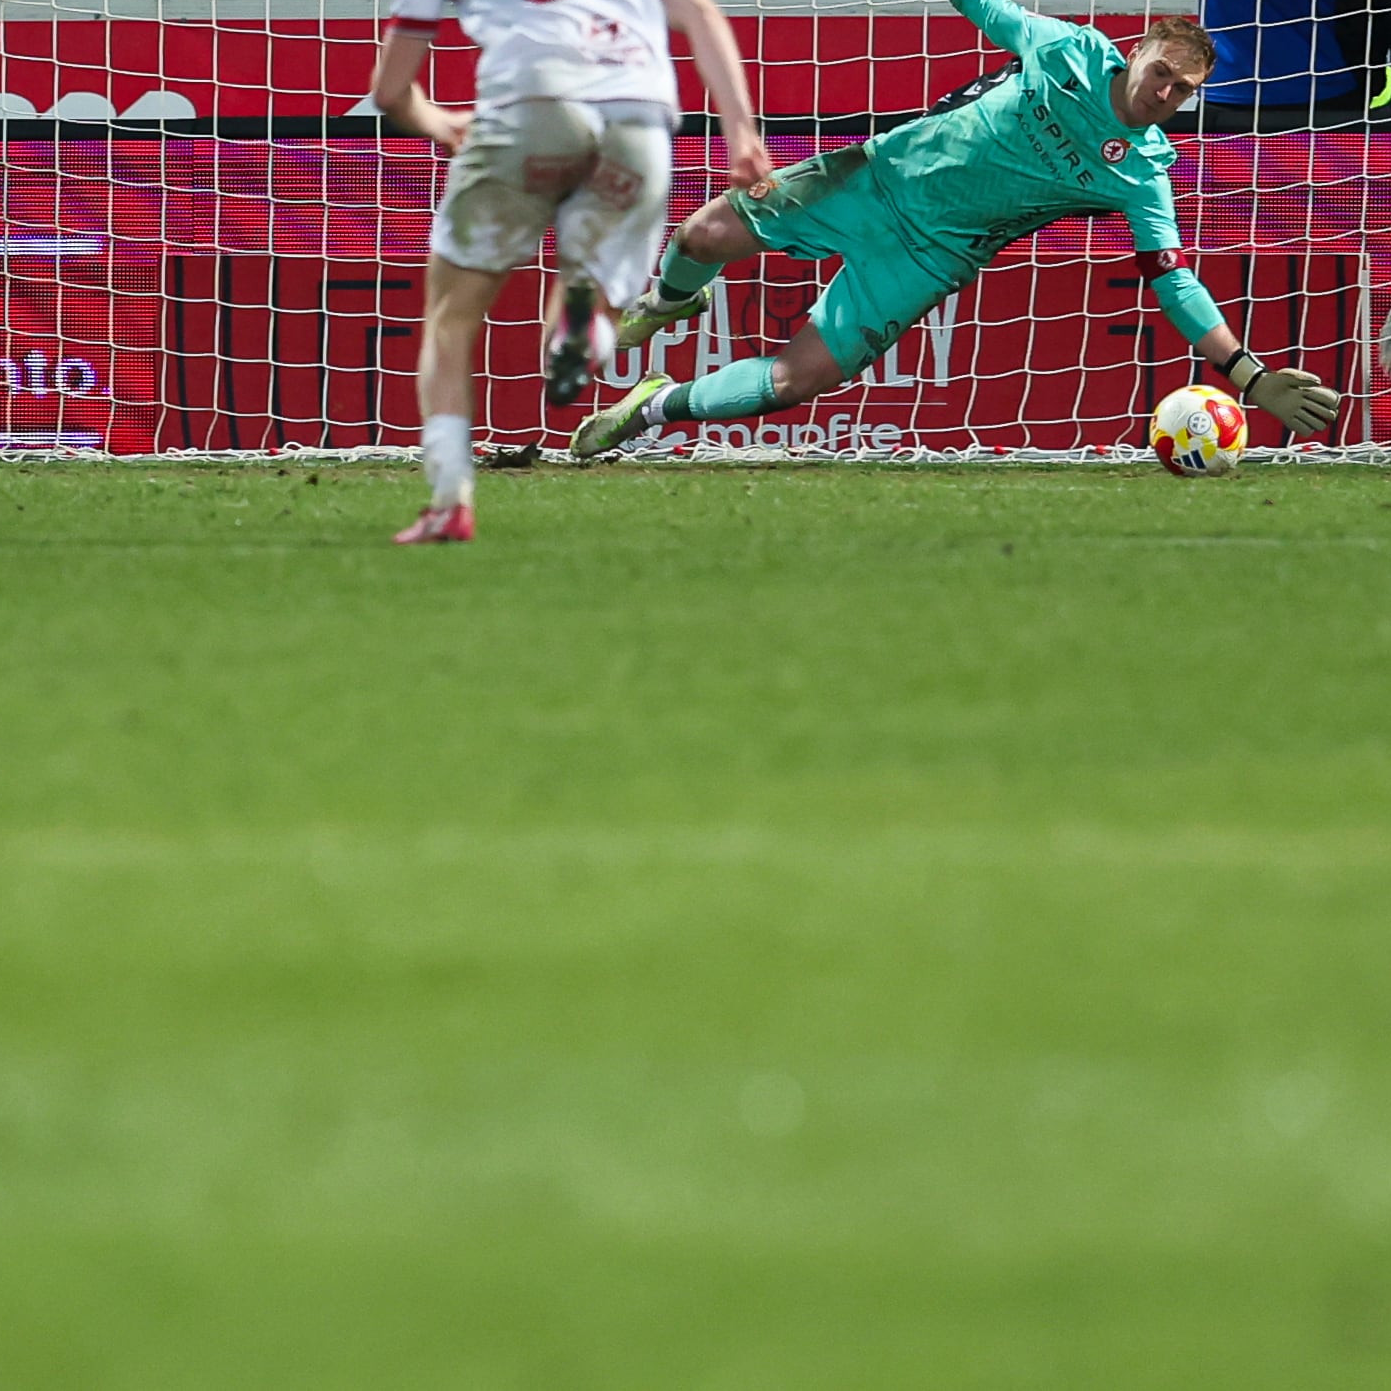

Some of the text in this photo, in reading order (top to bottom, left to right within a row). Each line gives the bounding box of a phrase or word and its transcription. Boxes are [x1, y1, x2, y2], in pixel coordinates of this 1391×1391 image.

[1014, 112, 1066, 182] ACADEMY
[1022, 88, 1095, 189] ASPIRE
[698, 413, 902, 454] mapfre
